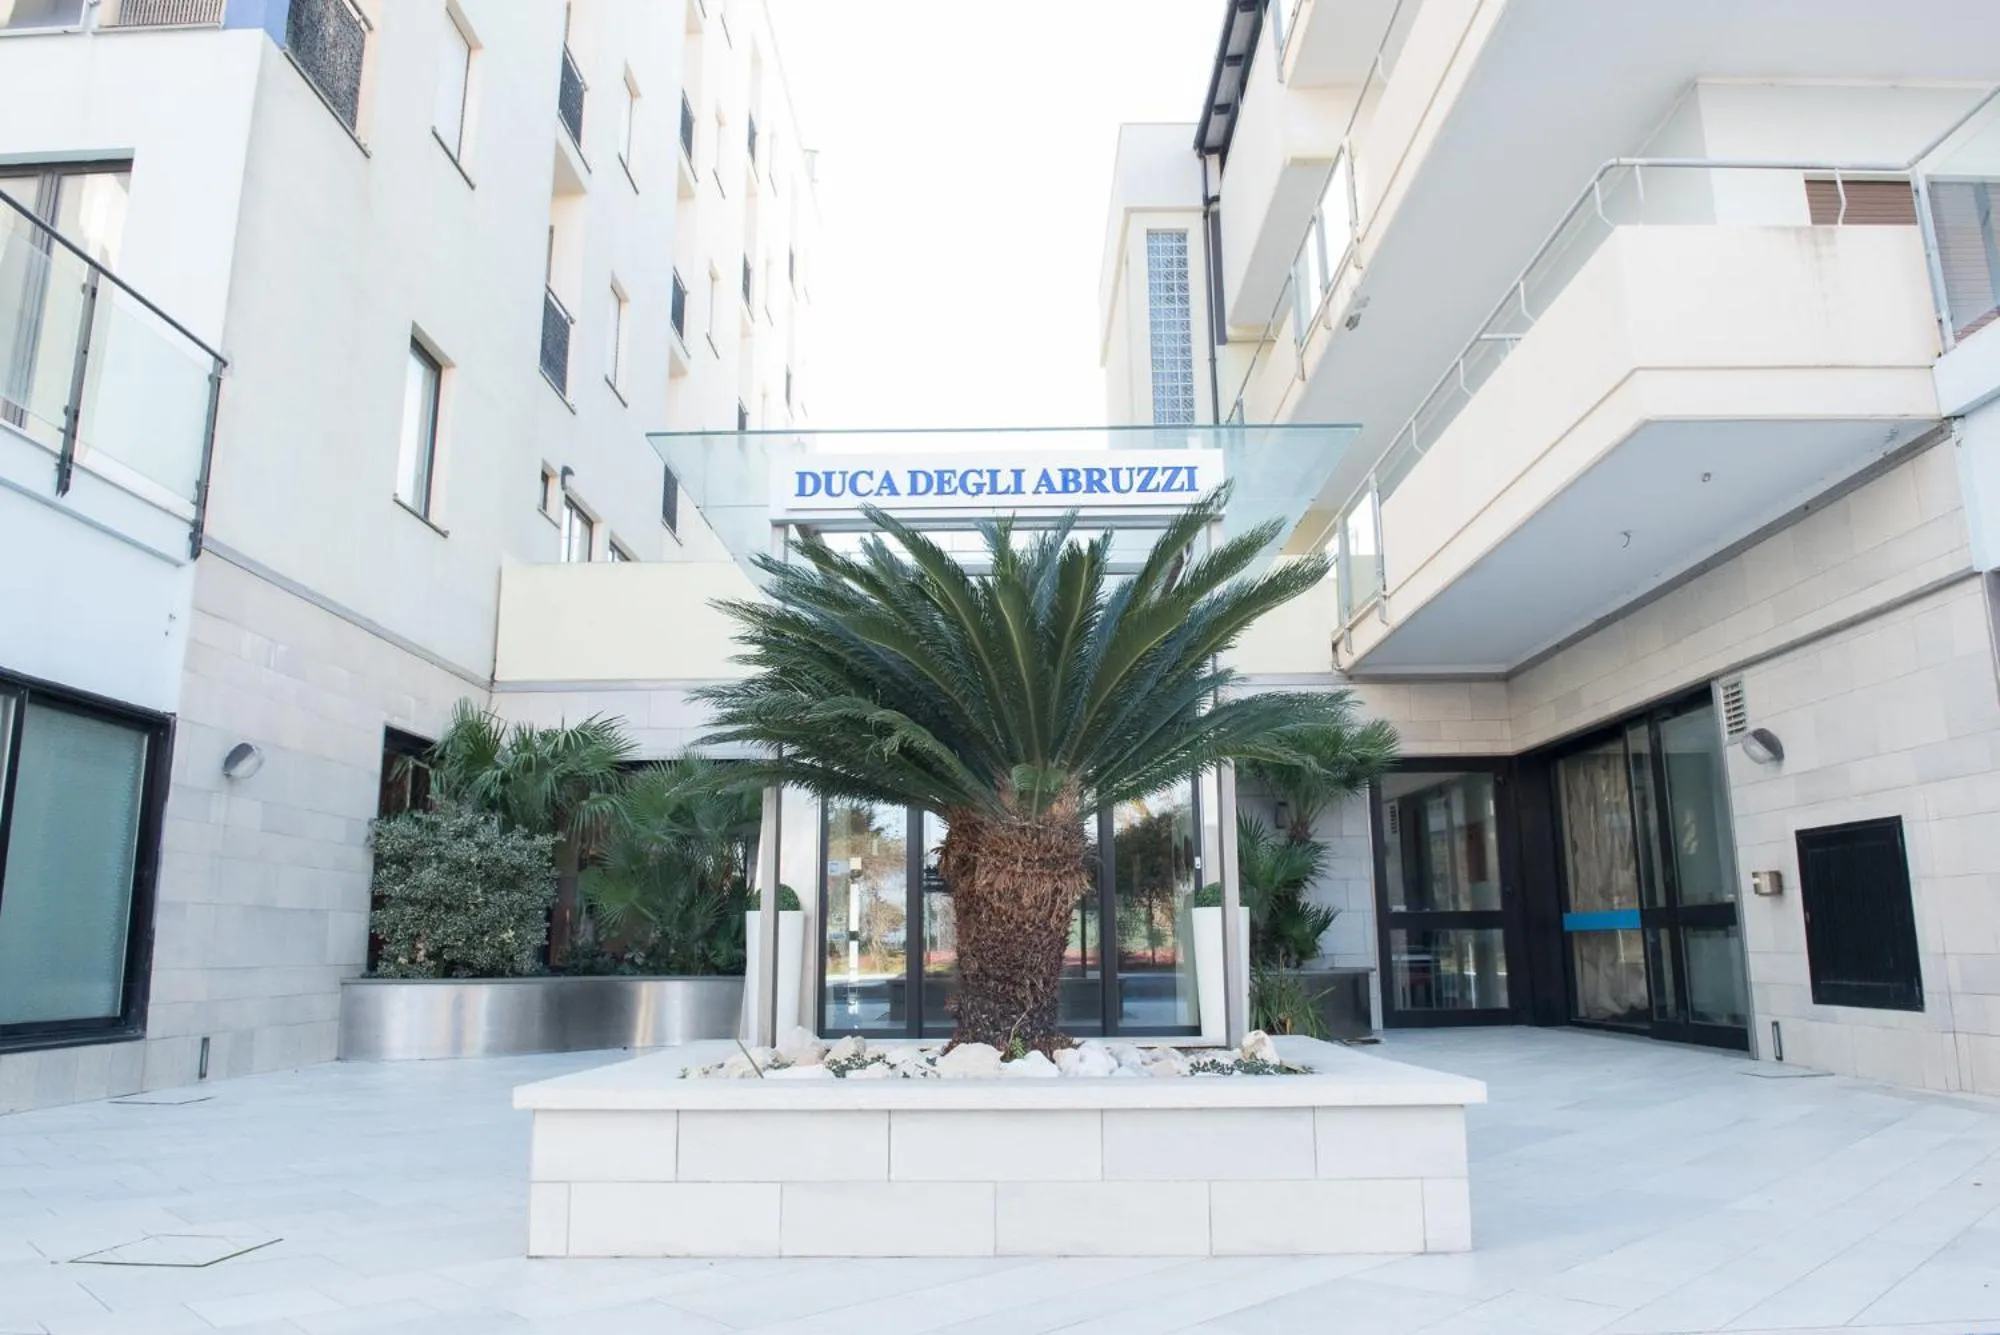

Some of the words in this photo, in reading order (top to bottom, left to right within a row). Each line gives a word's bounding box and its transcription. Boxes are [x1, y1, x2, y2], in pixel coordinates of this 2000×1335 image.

[796, 470, 900, 497] DUCA
[908, 469, 1025, 496] DEGLI
[1033, 466, 1198, 494] ABRUZZI
